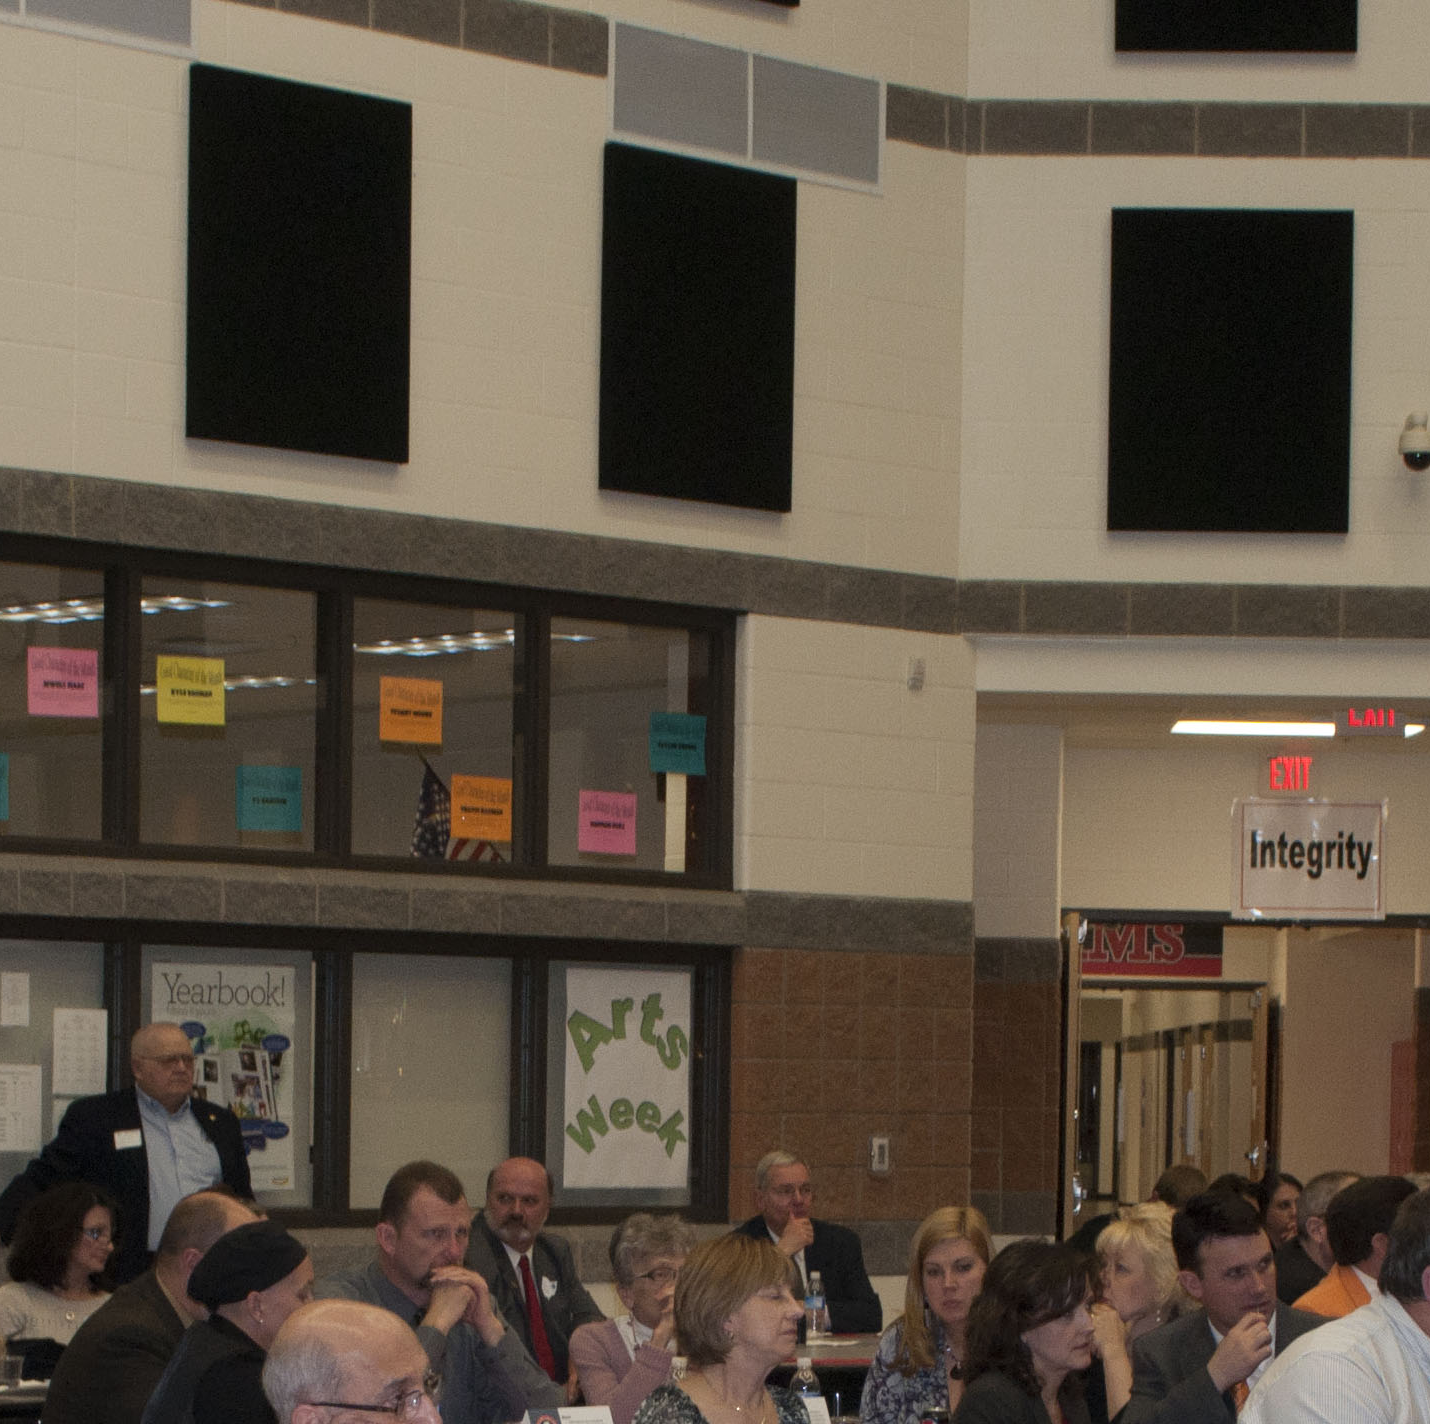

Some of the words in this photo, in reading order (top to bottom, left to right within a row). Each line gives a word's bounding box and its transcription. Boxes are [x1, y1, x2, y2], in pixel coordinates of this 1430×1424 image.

[1268, 756, 1312, 790] EXIT
[1250, 830, 1372, 880] Integrity
[161, 971, 286, 1008] Yearbook!
[567, 993, 688, 1074] Arts
[565, 1094, 687, 1159] Week
